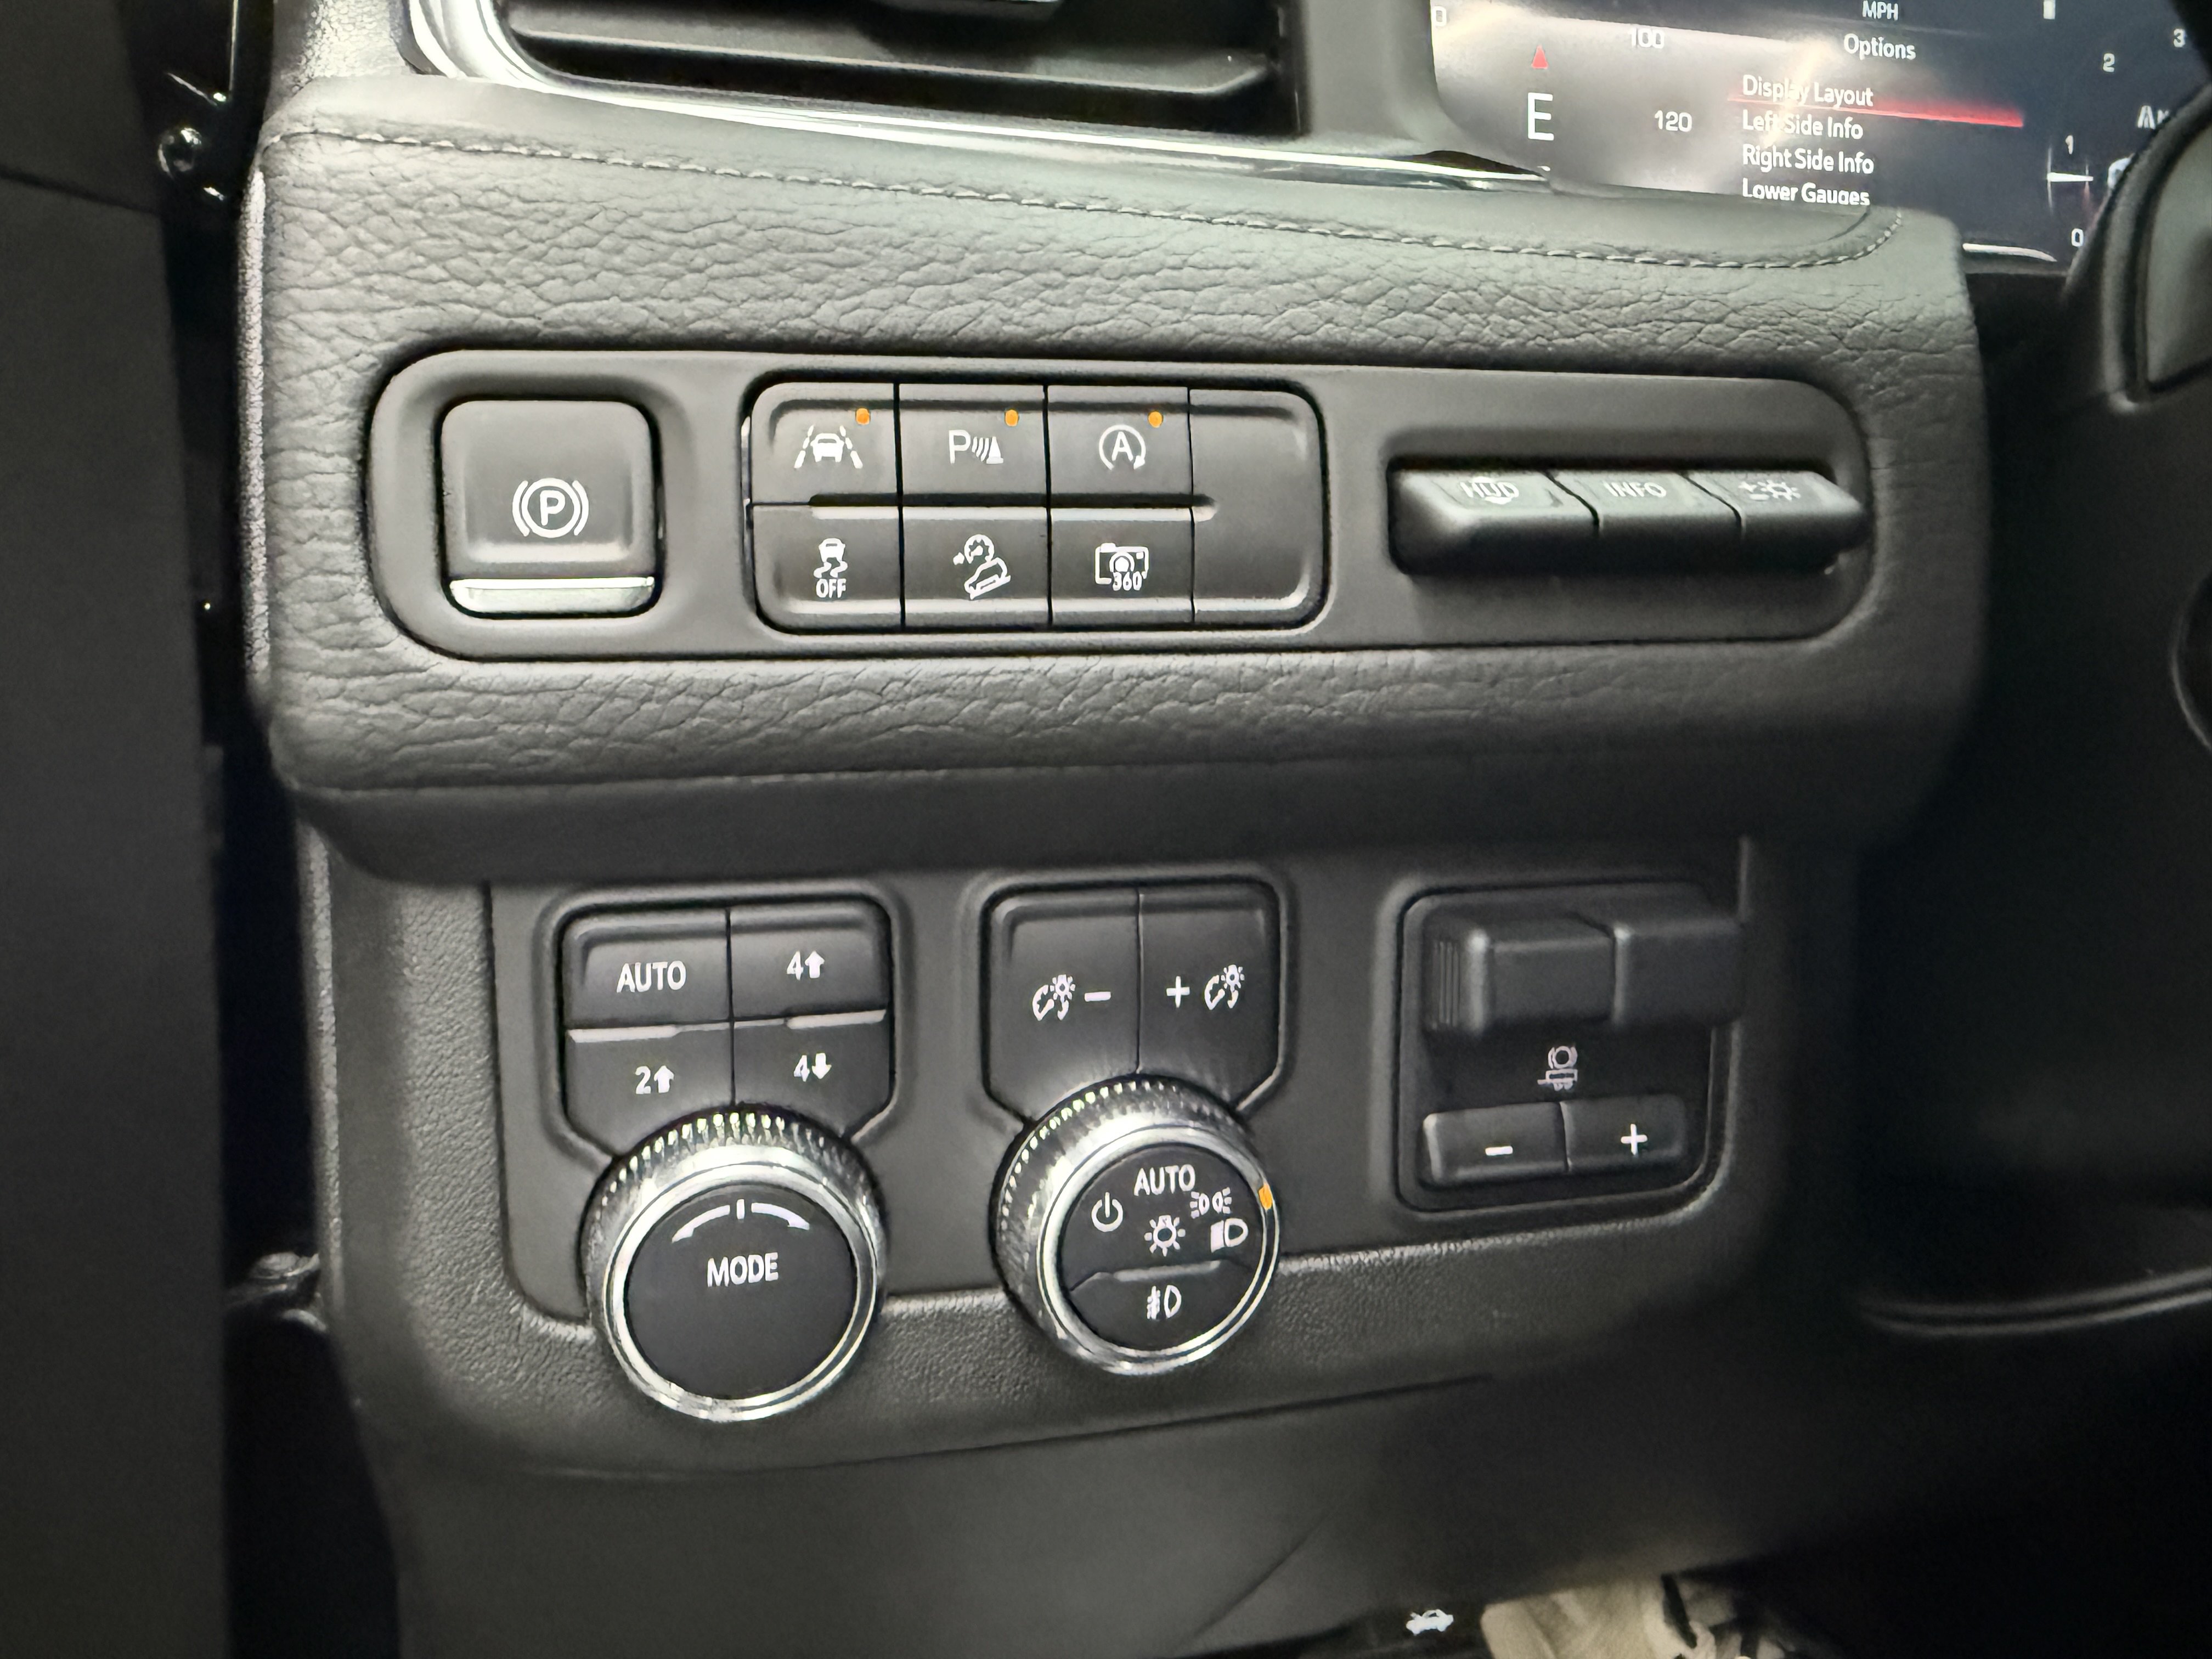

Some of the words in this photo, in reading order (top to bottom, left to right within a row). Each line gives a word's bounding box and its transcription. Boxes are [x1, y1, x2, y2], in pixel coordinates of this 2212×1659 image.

[1862, 0, 1899, 21] MPH
[1627, 27, 1665, 48] 100
[1844, 33, 1916, 60] Options
[2173, 28, 2186, 48] 3
[2102, 53, 2115, 72] 2
[1742, 74, 1809, 105] Display
[1814, 82, 1874, 108] Layout
[1528, 92, 1554, 141] E
[1654, 110, 1692, 132] 120
[1743, 109, 1781, 132] Left
[1784, 114, 1823, 136] Side
[1827, 116, 1863, 139] Info
[2065, 135, 2073, 155] 1
[1743, 143, 1792, 172] Right
[1795, 148, 1834, 171] Side
[1838, 150, 1874, 174] Info
[1742, 177, 1798, 201] Lower
[1602, 481, 1667, 498] INFO
[816, 578, 847, 599] OFF
[617, 960, 687, 993] AUTO
[1133, 1164, 1196, 1197] AUTO
[707, 1252, 779, 1288] MODE
